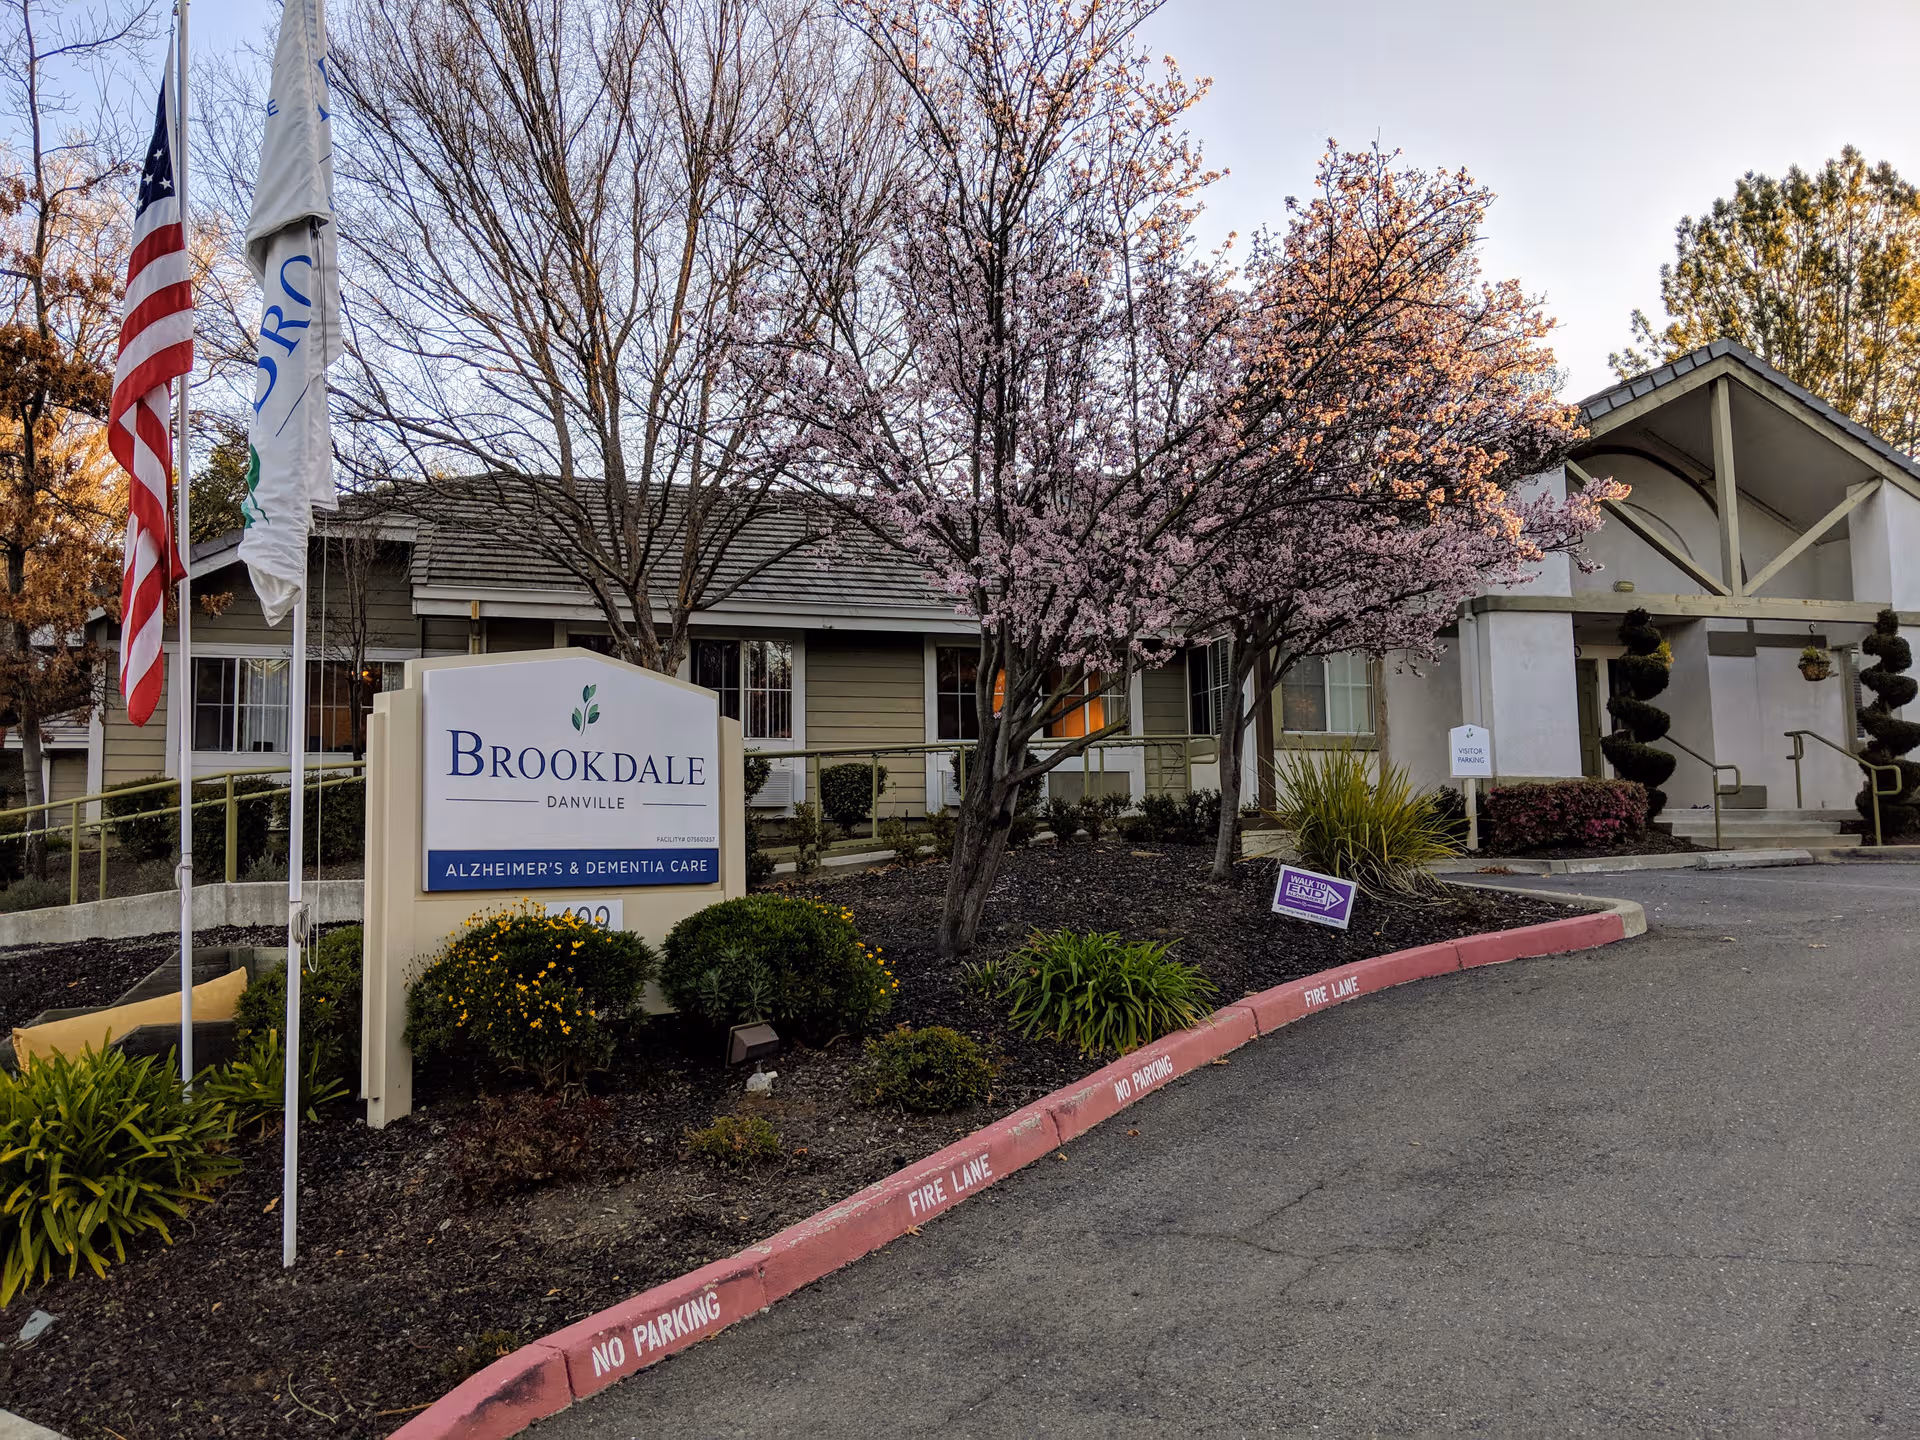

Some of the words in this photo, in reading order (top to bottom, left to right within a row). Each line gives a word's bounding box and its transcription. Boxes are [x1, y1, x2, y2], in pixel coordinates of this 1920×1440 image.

[446, 729, 706, 786] BROOKDALE
[1457, 756, 1485, 764] PARKING
[1458, 747, 1483, 755] VISITOR
[547, 795, 625, 810] DANVILLE
[445, 862, 563, 878] ALZHEIMER'S
[569, 861, 580, 875] &
[586, 860, 665, 875] DEMENTIA
[670, 859, 708, 873] CARE
[1288, 883, 1325, 899] END
[1291, 874, 1315, 888] WALK
[1315, 881, 1327, 890] TO
[1304, 985, 1329, 1008] FIRE
[1332, 976, 1360, 999] LANE
[1114, 1078, 1132, 1102] NO
[1132, 1055, 1174, 1092] PARKING
[908, 1178, 948, 1218] FIRE
[951, 1153, 993, 1194] LANE
[591, 1335, 626, 1377] NO
[632, 1291, 721, 1358] PARKING
